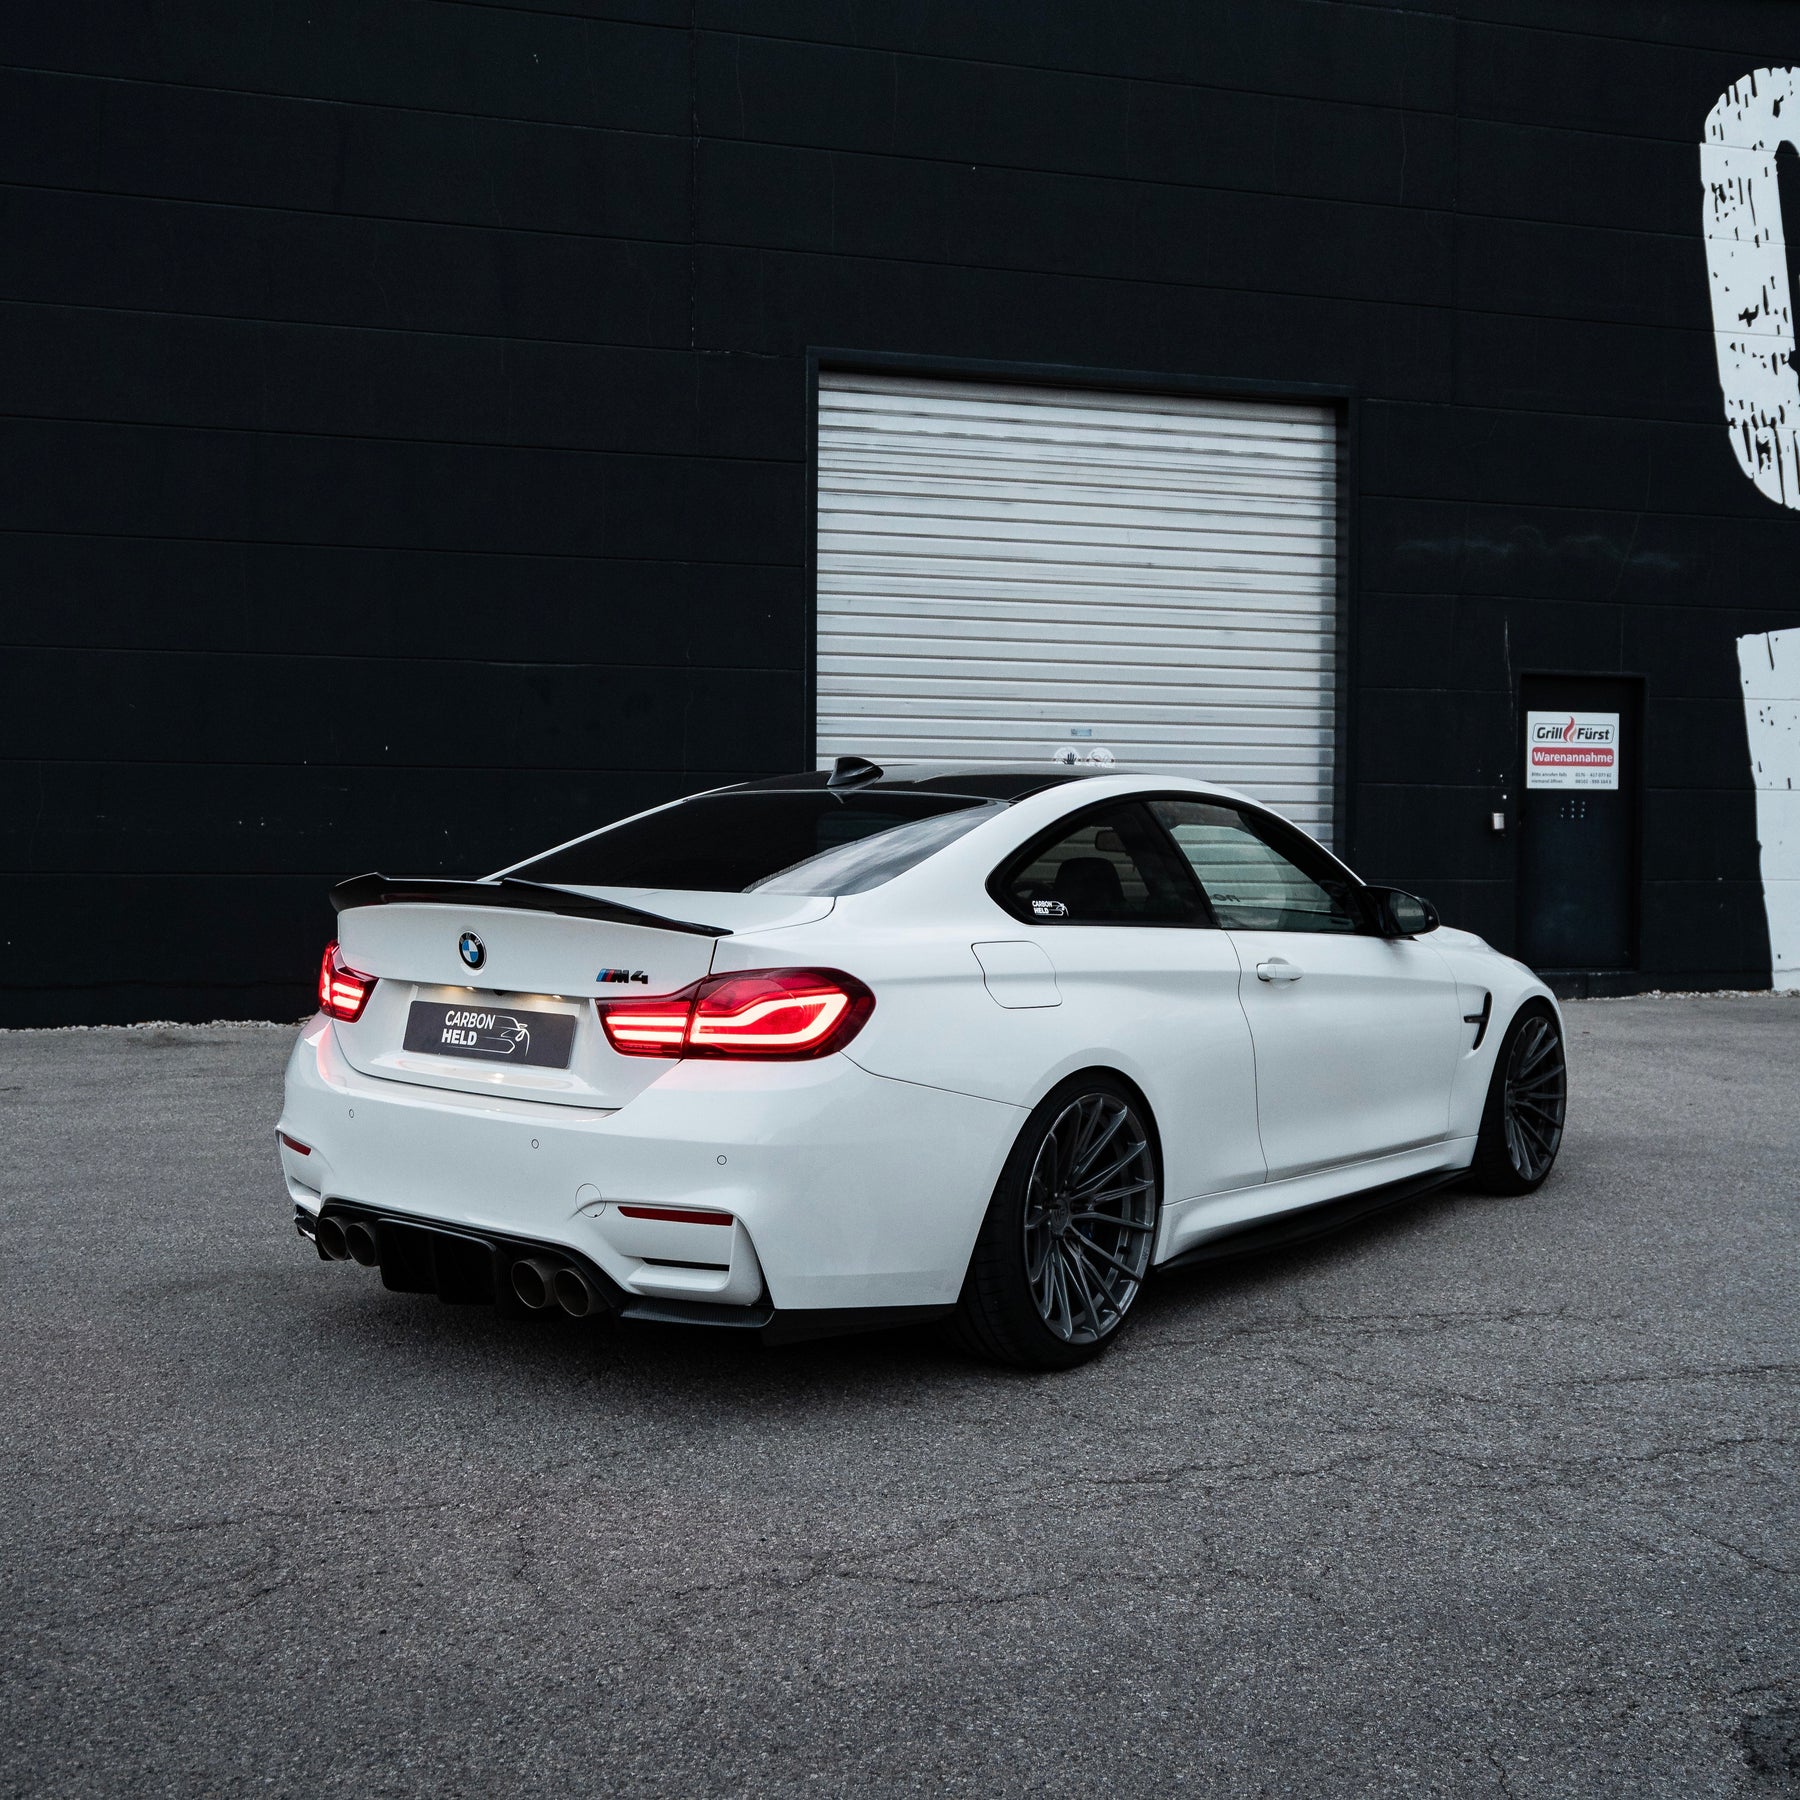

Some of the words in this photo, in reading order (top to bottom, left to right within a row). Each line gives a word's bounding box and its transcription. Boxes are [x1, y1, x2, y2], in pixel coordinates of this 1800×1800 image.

[1536, 727, 1563, 739] Grill
[1577, 728, 1610, 740] Fürst
[1533, 751, 1613, 763] Warenannahme
[445, 1010, 497, 1030] CARBON
[441, 1028, 478, 1046] HELD
